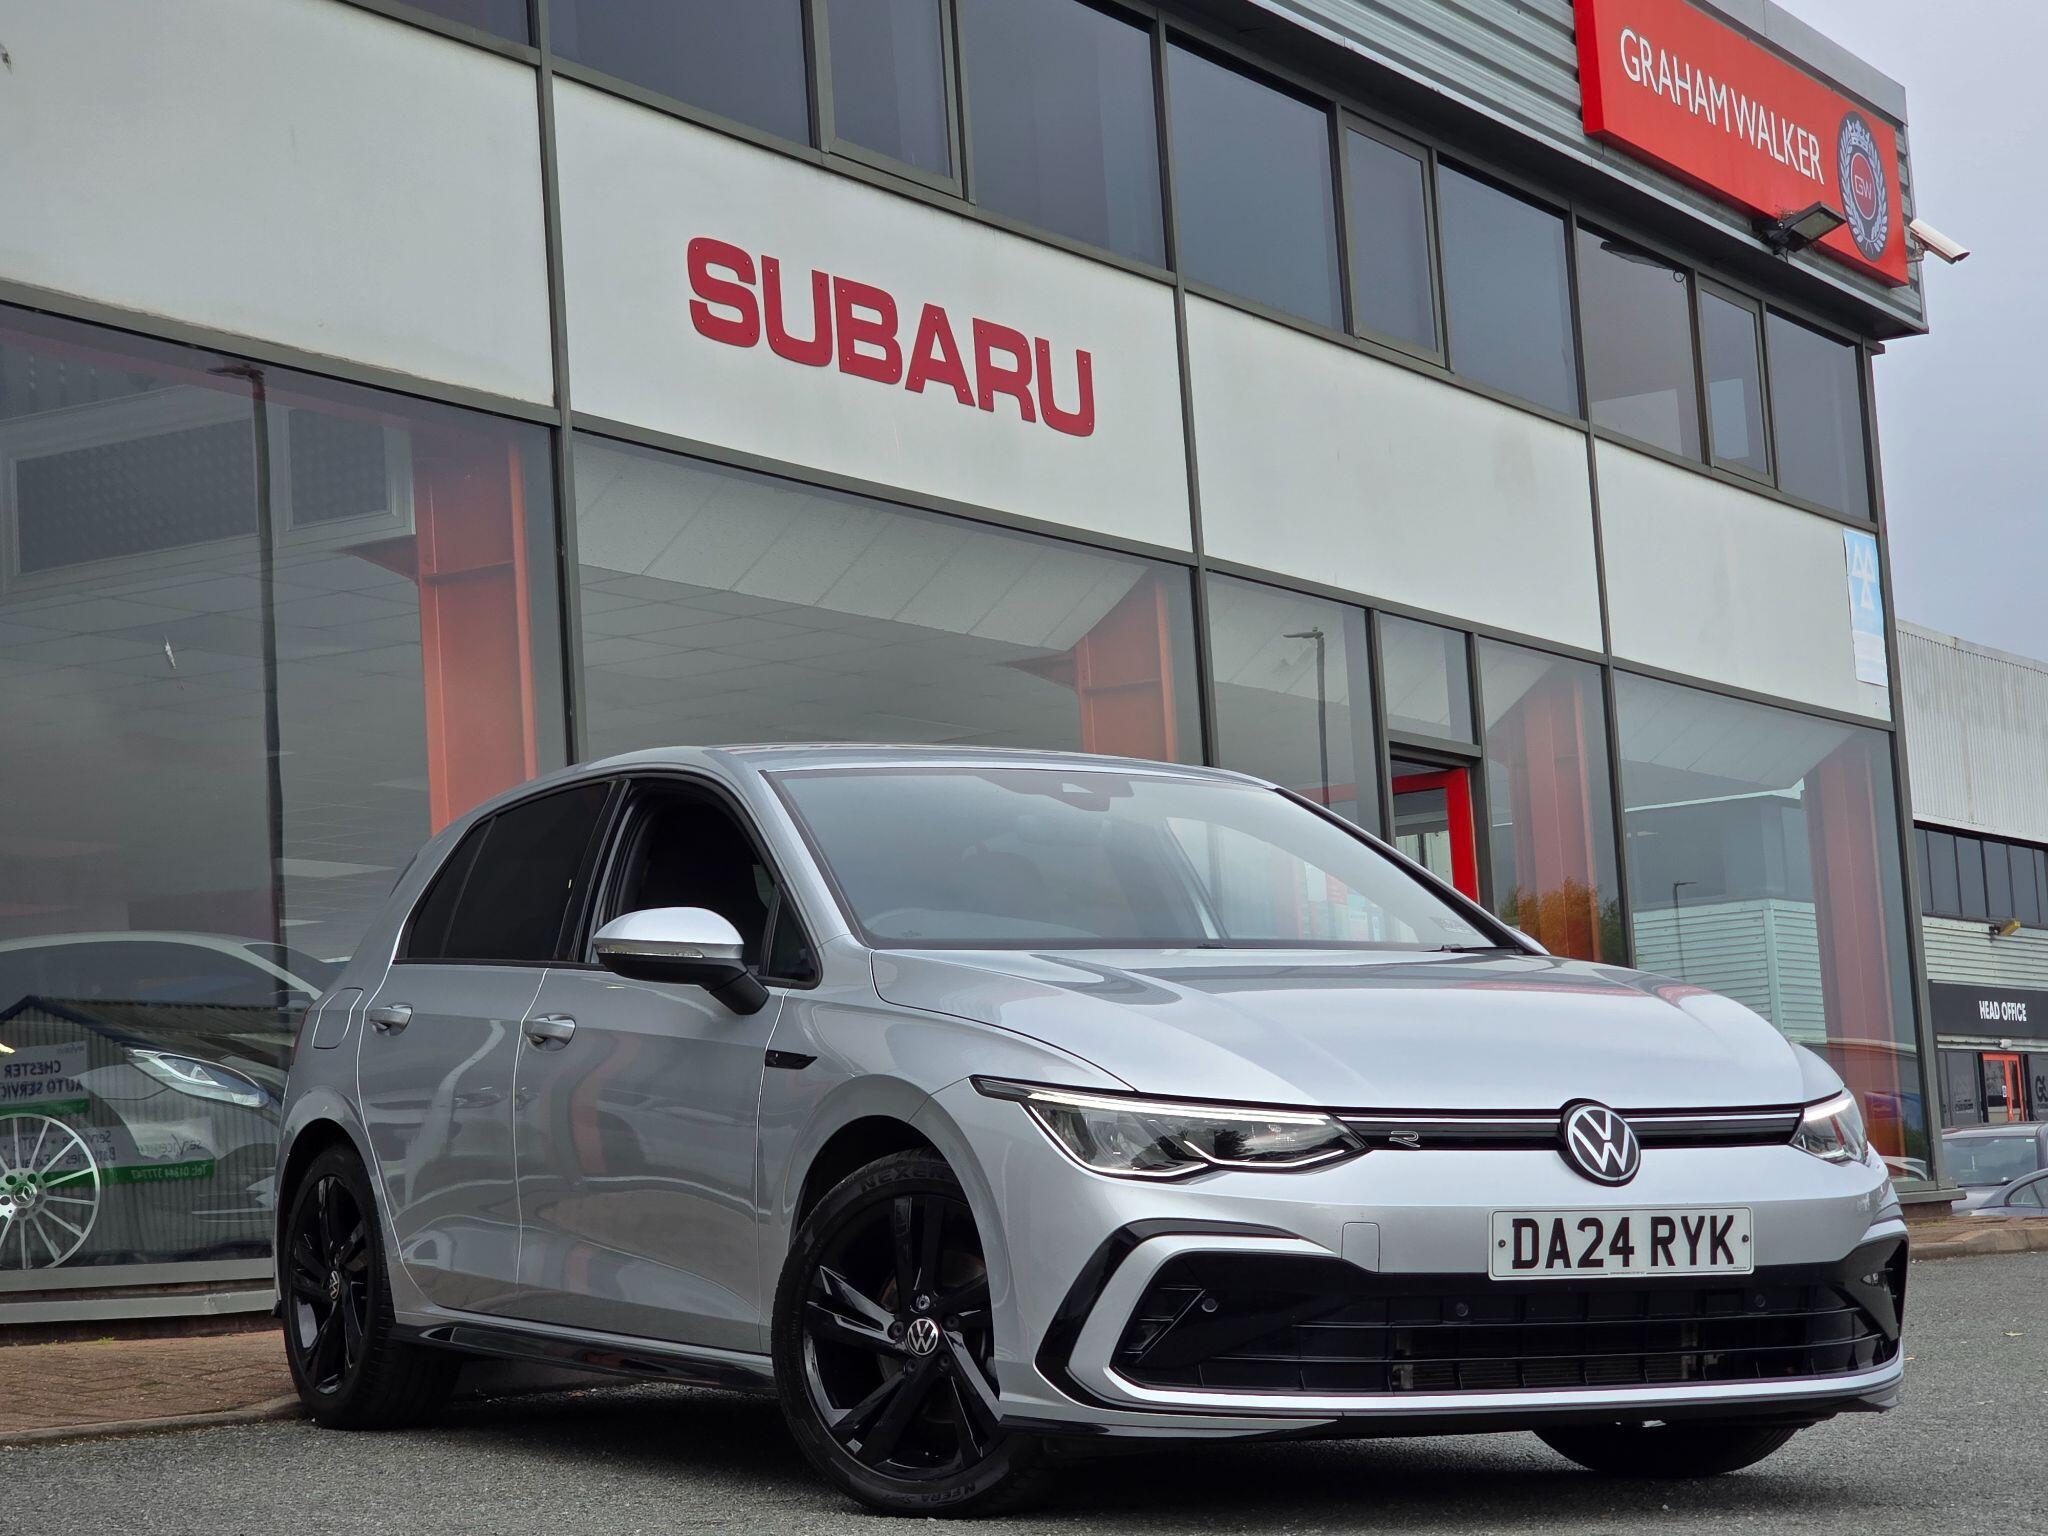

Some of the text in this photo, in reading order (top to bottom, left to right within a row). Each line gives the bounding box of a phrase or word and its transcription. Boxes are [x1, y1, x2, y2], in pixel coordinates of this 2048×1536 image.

[1620, 26, 1824, 185] GRAHAM WALKER
[1854, 174, 1872, 201] GW
[687, 237, 1095, 437] SUBARU
[1979, 1000, 2027, 1022] HEAD OFFICE
[1512, 1215, 1737, 1270] DA24 RYK
